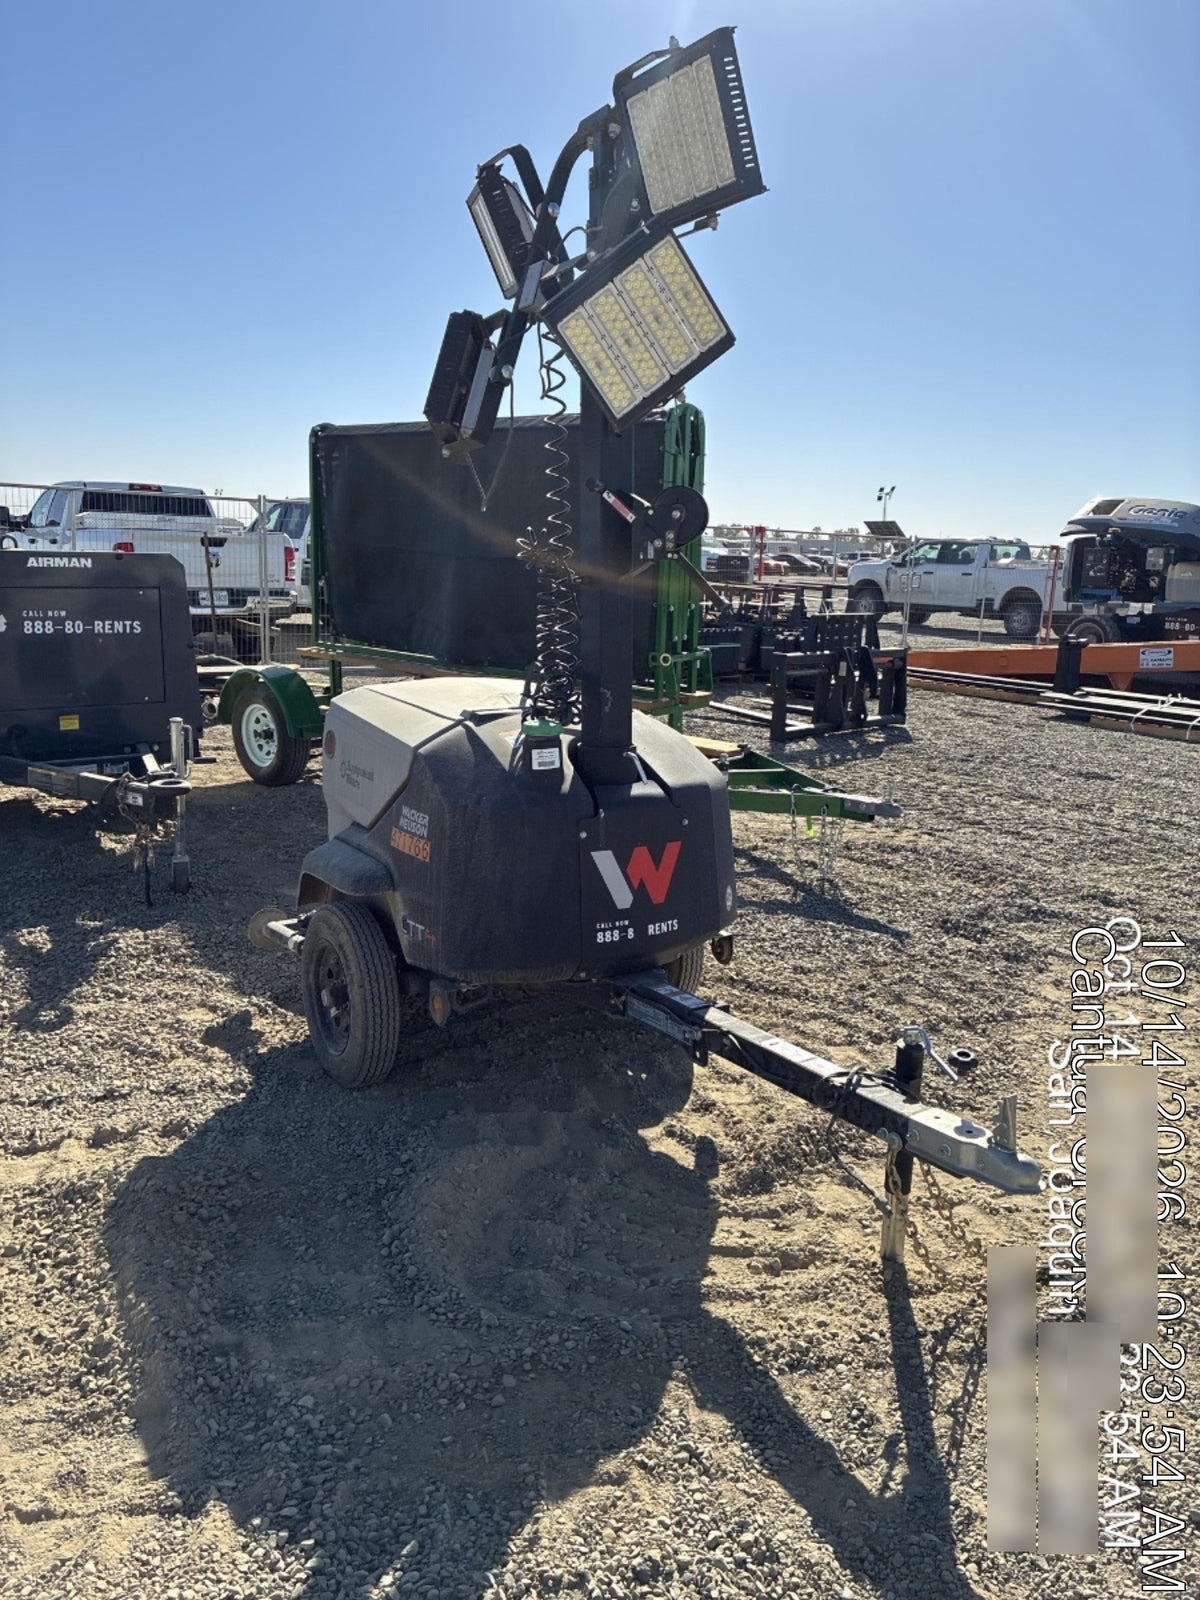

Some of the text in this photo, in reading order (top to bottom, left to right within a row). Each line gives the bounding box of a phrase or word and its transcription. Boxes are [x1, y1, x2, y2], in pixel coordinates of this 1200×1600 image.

[1128, 504, 1188, 519] Genie
[26, 556, 93, 568] AIRMAN
[23, 620, 142, 634] 888-80-RENTS
[402, 805, 429, 827] WACKER
[399, 815, 429, 838] NEUSON
[596, 919, 629, 929] CALL NOW
[647, 919, 678, 936] RENTS
